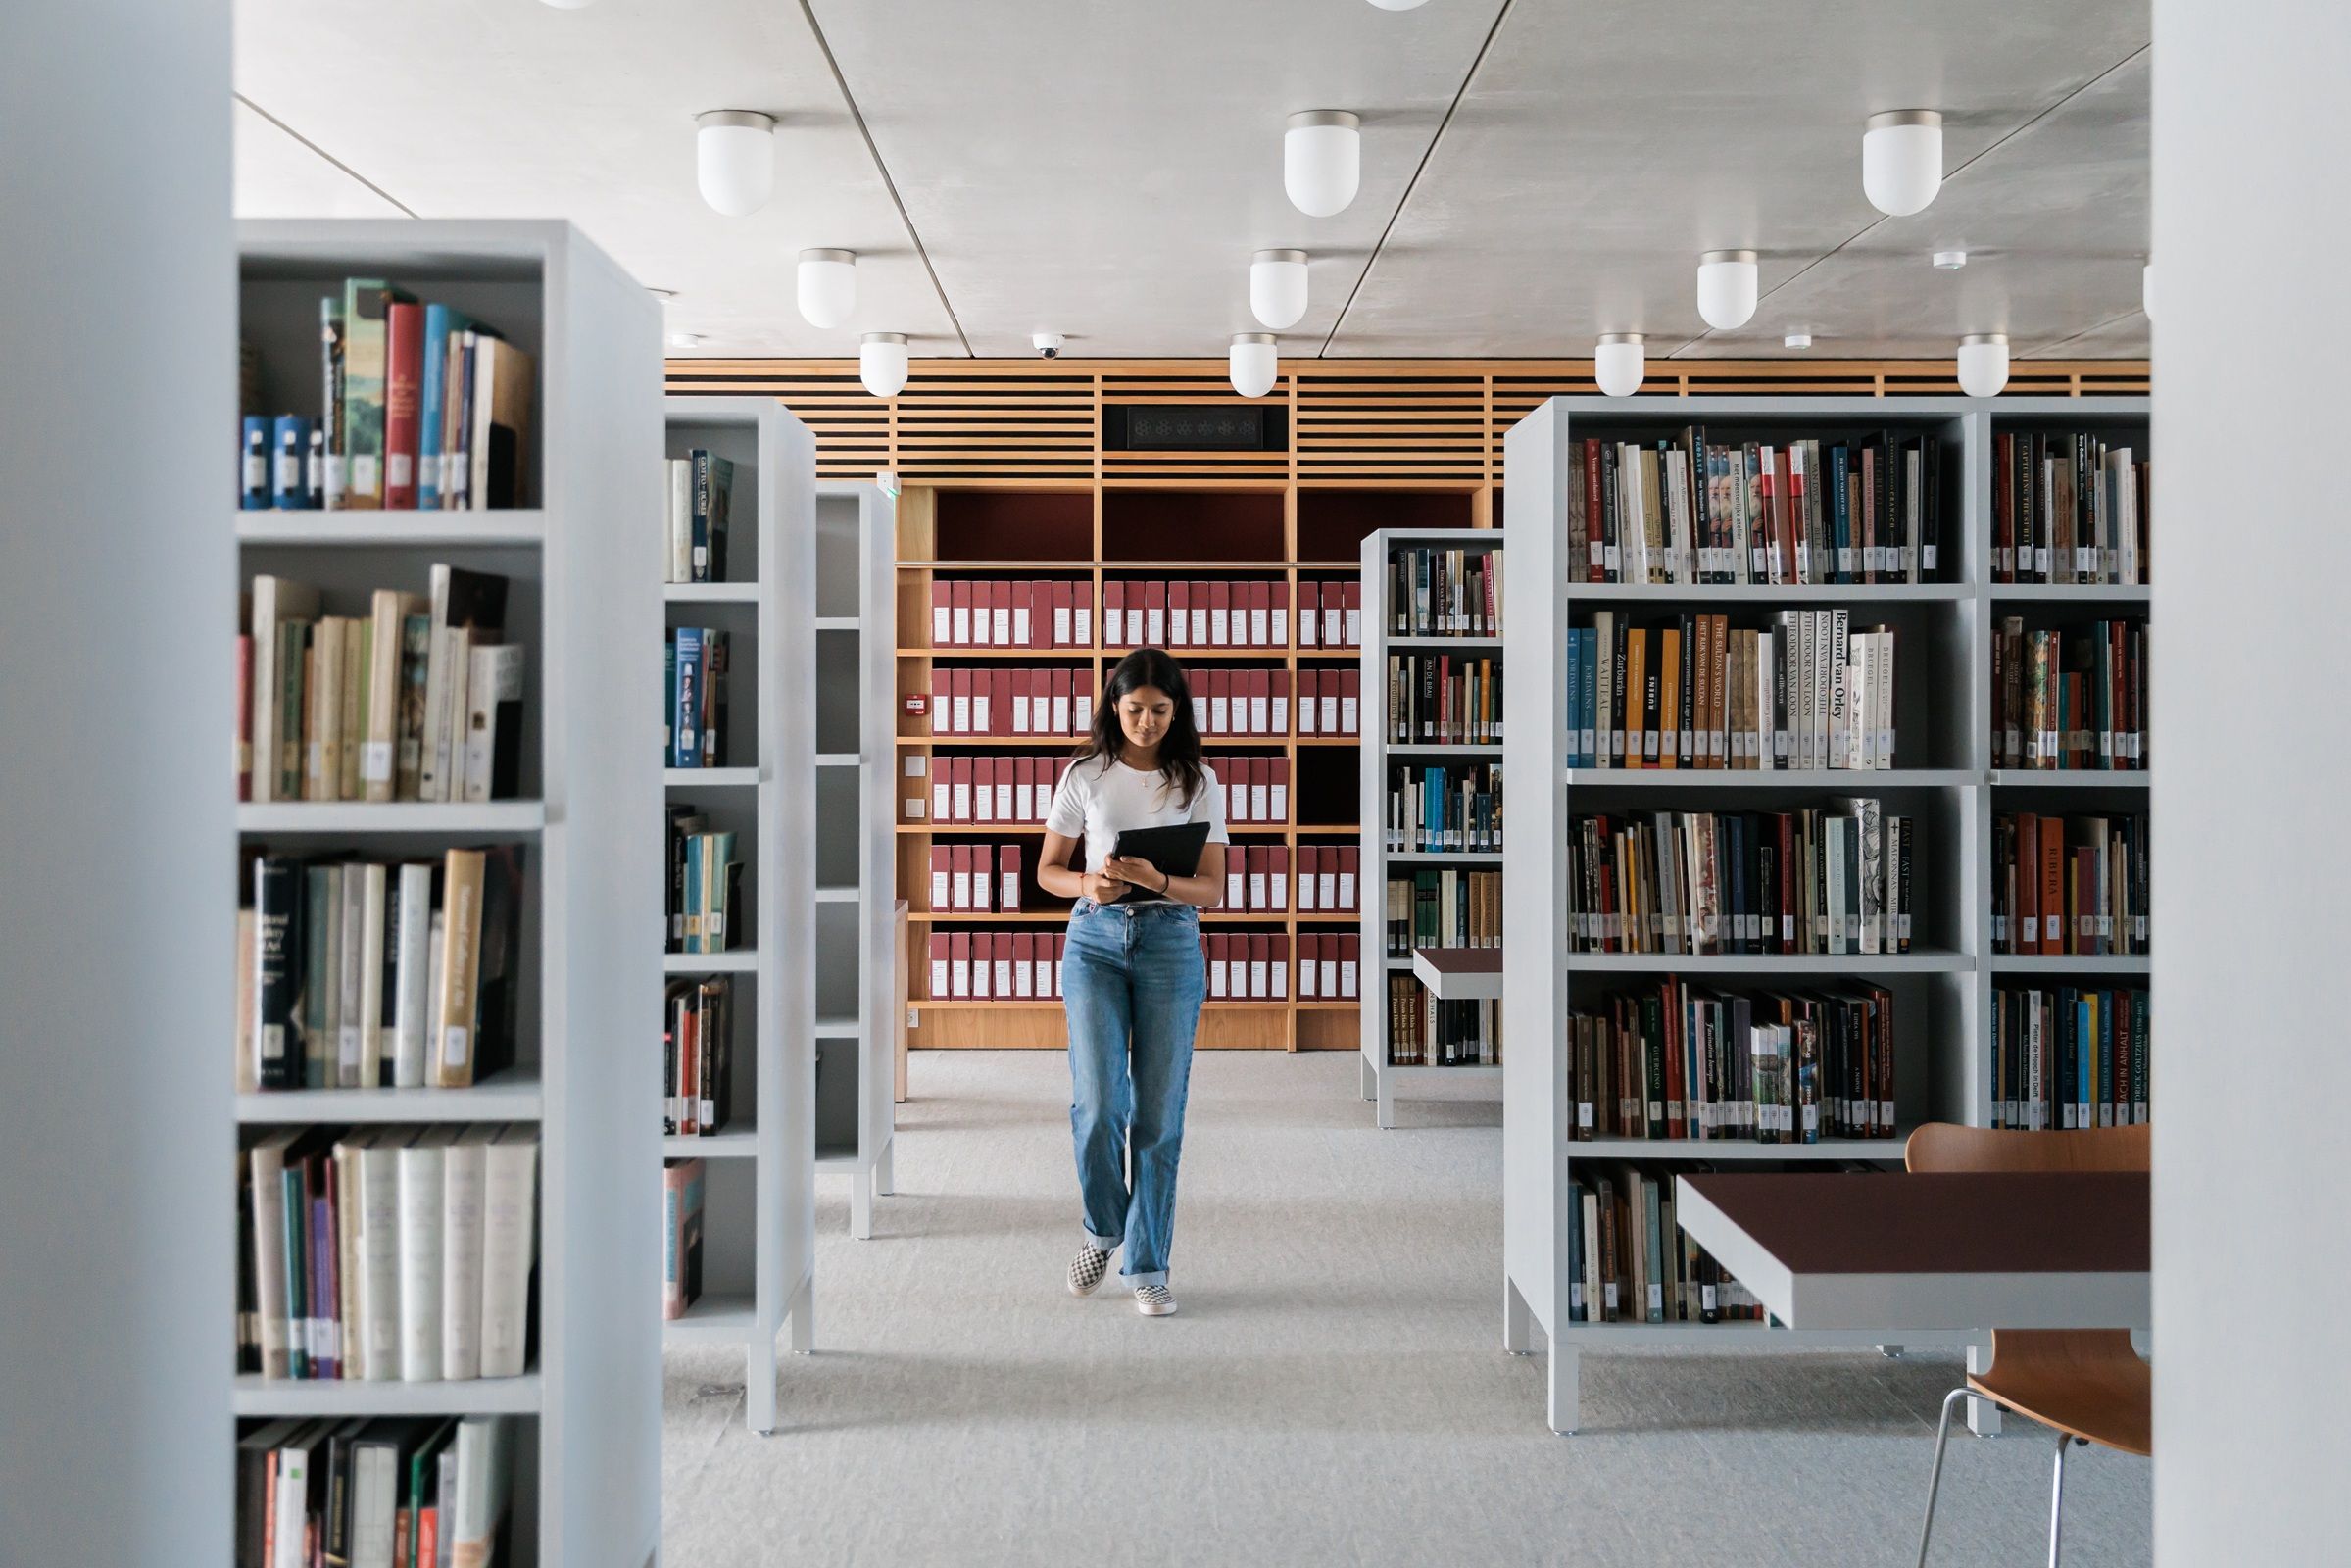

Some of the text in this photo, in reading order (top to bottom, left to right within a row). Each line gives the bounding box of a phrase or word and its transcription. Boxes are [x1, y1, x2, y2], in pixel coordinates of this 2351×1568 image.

[1733, 476, 1741, 516] meesterlijke
[1803, 613, 1812, 667] THEODOOR
[1820, 613, 1829, 641] LOON
[1616, 654, 1626, 696] Zurbarán
[1698, 668, 1705, 678] DE
[1714, 640, 1723, 675] SULTAN'S
[1788, 615, 1797, 717] THEODOOR VAN LOON
[1832, 612, 1847, 719] Bernard van Orley
[1599, 658, 1609, 712] WATTEAU
[1697, 678, 1706, 706] SULTAN
[1713, 676, 1722, 707] WORLD
[1901, 856, 1910, 878] FAST
[2048, 848, 2058, 895] RIBERA
[1705, 1022, 1715, 1084] Fascination baroque
[2033, 1044, 2039, 1053] de
[2119, 1030, 2128, 1065] ANHALT
[2119, 1068, 2128, 1077] IN
